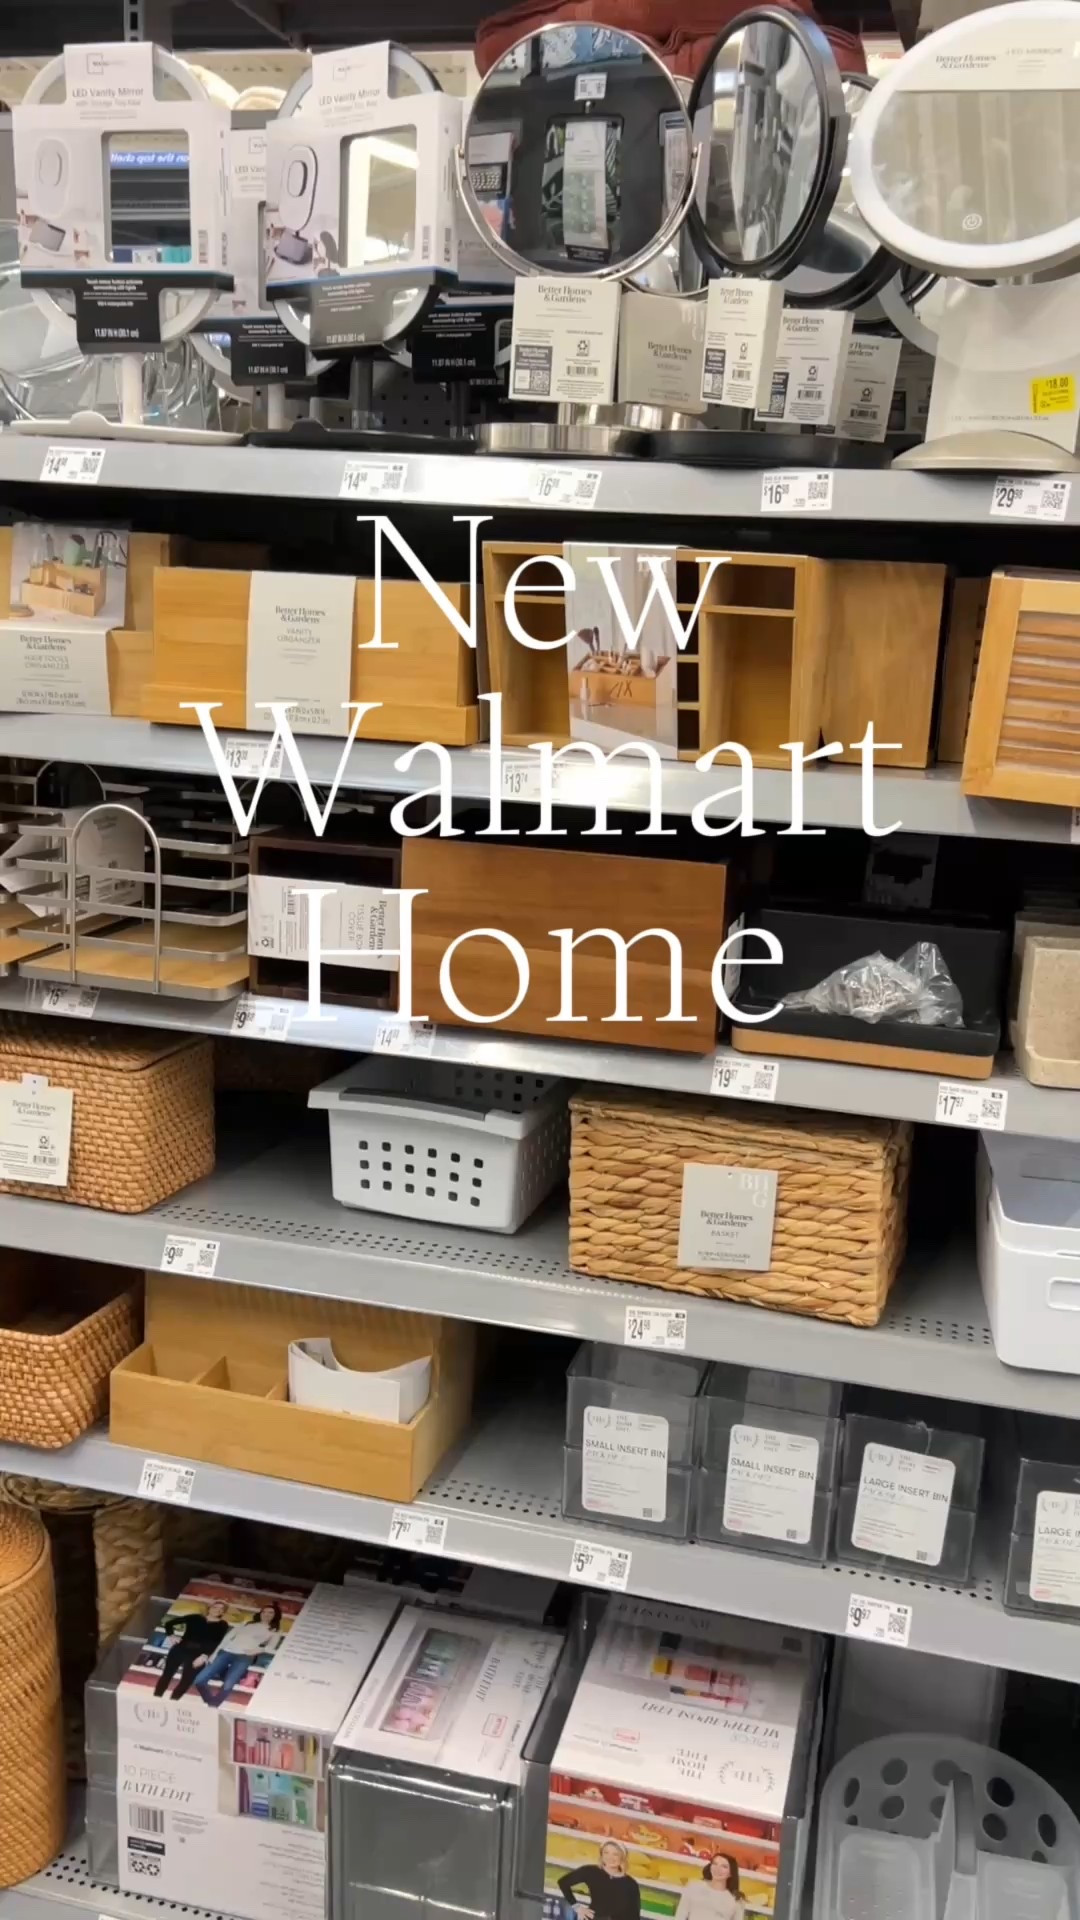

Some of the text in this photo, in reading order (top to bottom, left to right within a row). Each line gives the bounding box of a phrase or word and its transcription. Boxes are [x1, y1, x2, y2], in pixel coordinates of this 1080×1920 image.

[72, 87, 144, 99] LED Vanity Mirror
[319, 88, 381, 106] LED Vanity Mirror
[538, 284, 593, 296] Better Homes
[735, 287, 754, 298] Homes
[802, 316, 825, 326] Homes
[648, 342, 693, 355] Better Homes
[275, 605, 326, 617] Better Homes
[286, 627, 312, 637] VANITY
[20, 634, 72, 645] Better Homes
[276, 635, 321, 645] ORGANIZER
[24, 662, 70, 671] ORGANIZER
[356, 904, 365, 931] TISSUE
[348, 911, 357, 941] COVER
[376, 928, 386, 959] Homs
[12, 1100, 56, 1112] Better Homes
[701, 1210, 753, 1222] Better Homes
[711, 1230, 740, 1239] BASKET
[585, 1439, 666, 1460] SMALL INSERT BIN
[731, 1457, 761, 1471] SMALL
[763, 1463, 797, 1477] INSERT
[798, 1470, 815, 1480] BIN
[863, 1476, 896, 1491] LARGE
[898, 1484, 931, 1498] INSERT
[932, 1491, 949, 1503] BIN
[1038, 1526, 1072, 1538] LARGE
[641, 1701, 780, 1740] MULTIPURPOSE EDIT
[123, 1764, 177, 1784] 10 PIECE
[122, 1780, 195, 1804] BATH EDIT
